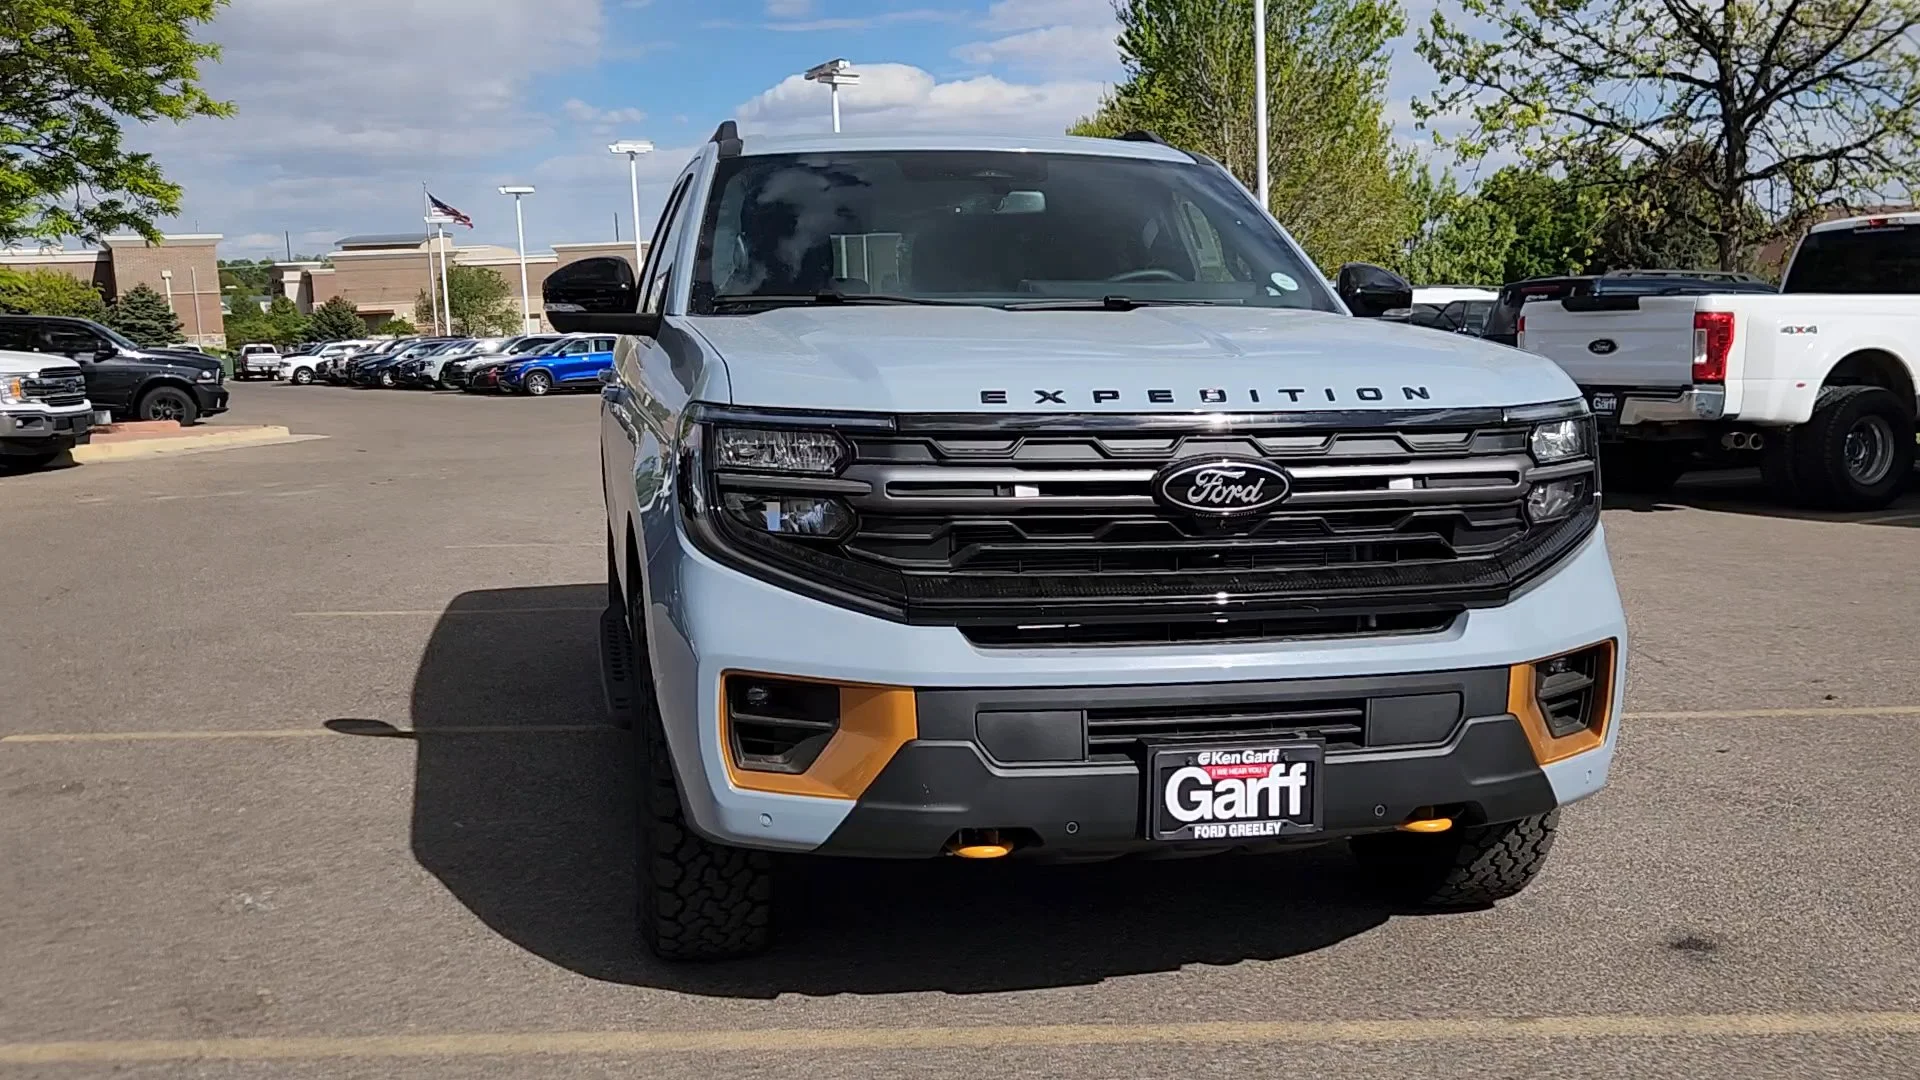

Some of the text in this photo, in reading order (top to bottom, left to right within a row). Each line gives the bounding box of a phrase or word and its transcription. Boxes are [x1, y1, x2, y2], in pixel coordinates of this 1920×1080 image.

[980, 385, 1431, 405] EXPEDITION
[1187, 469, 1265, 504] Ford
[1211, 751, 1241, 765] Ken
[1242, 749, 1280, 764] Garff
[1165, 762, 1307, 822] Garff
[1194, 822, 1282, 839] FORD GREELEY
